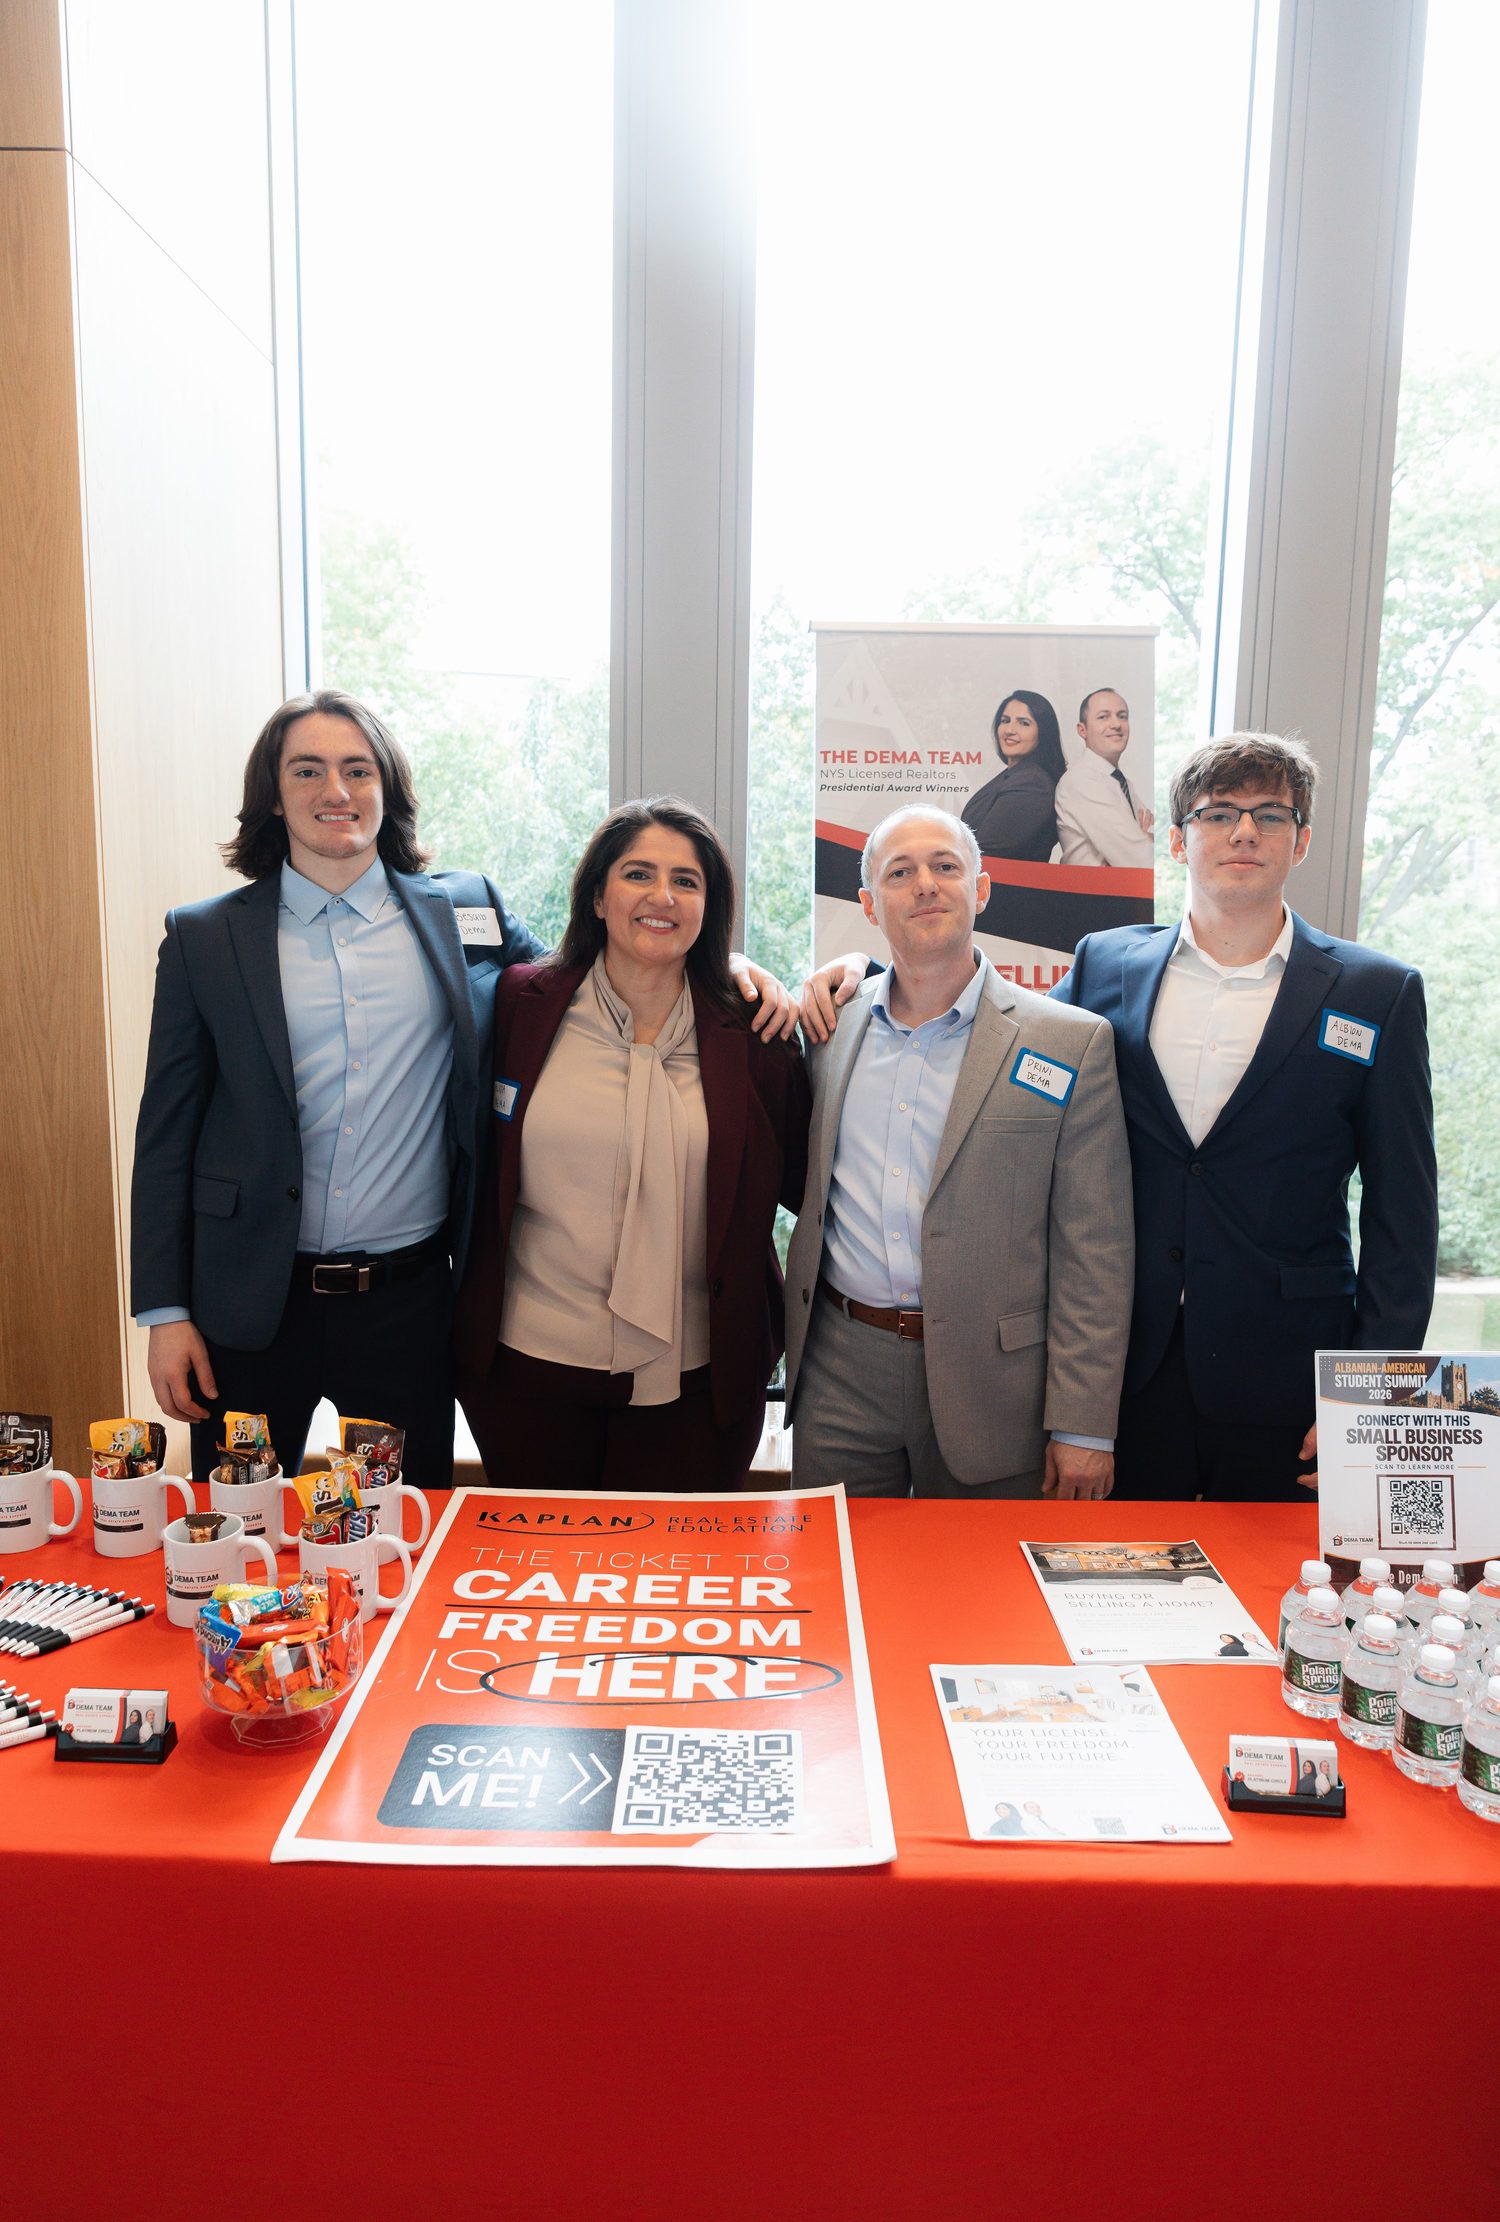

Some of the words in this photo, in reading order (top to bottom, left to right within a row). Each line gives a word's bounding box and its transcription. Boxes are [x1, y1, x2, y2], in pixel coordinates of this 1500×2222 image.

[820, 750, 858, 764] THE
[864, 750, 922, 765] DEMA
[927, 751, 982, 765] TEAM
[820, 769, 844, 779] NYS
[848, 769, 903, 779] Licensed
[906, 769, 957, 779] Realtors
[819, 783, 884, 792] Presidential
[886, 784, 922, 792] Award
[925, 784, 970, 793] Winners
[1337, 1036, 1362, 1051] DEMA
[1027, 1058, 1053, 1076] DRINI
[1026, 1071, 1050, 1088] DEMA
[1334, 1362, 1426, 1374] ALBANIAN-AMERICAN
[1334, 1374, 1382, 1388] STUDENT
[1384, 1375, 1428, 1388] SUMMIT
[1368, 1389, 1392, 1400] 2026
[1357, 1414, 1410, 1427] CONNECT
[1412, 1415, 1442, 1426] WITH
[1444, 1415, 1470, 1427] THIS
[1346, 1428, 1402, 1445] SMALL
[1405, 1429, 1483, 1445] BUSINESS
[1376, 1445, 1454, 1462] SPONSOR
[5, 1504, 28, 1513] TEAM
[100, 1509, 117, 1517] DEMA
[119, 1509, 140, 1517] TEAM
[242, 1513, 263, 1522] TEAM
[478, 1511, 634, 1527] KAPLAN
[668, 1515, 725, 1525] REAL
[733, 1514, 813, 1525] ESTATE
[667, 1524, 805, 1533] EDUCATION
[470, 1546, 555, 1567] THE
[569, 1551, 722, 1571] TICKET
[736, 1553, 790, 1572] TO
[174, 1574, 194, 1583] DEMA
[196, 1573, 219, 1583] TEAM
[1398, 1570, 1424, 1584] Dem
[452, 1568, 795, 1607] CAREER
[1063, 1592, 1125, 1600] BUYING
[1131, 1592, 1155, 1600] OR
[437, 1611, 801, 1647] FREEDOM
[415, 1648, 501, 1695] IS
[528, 1650, 803, 1700] HERE
[1301, 1664, 1338, 1676] Poland
[1302, 1675, 1339, 1688] Spring
[970, 1728, 1024, 1738] YOUR
[974, 1740, 1028, 1749] YOUR
[426, 1743, 551, 1768] SCAN
[977, 1752, 1033, 1761] YOUR
[1265, 1753, 1284, 1761] TEAM
[411, 1770, 543, 1809] ME!
